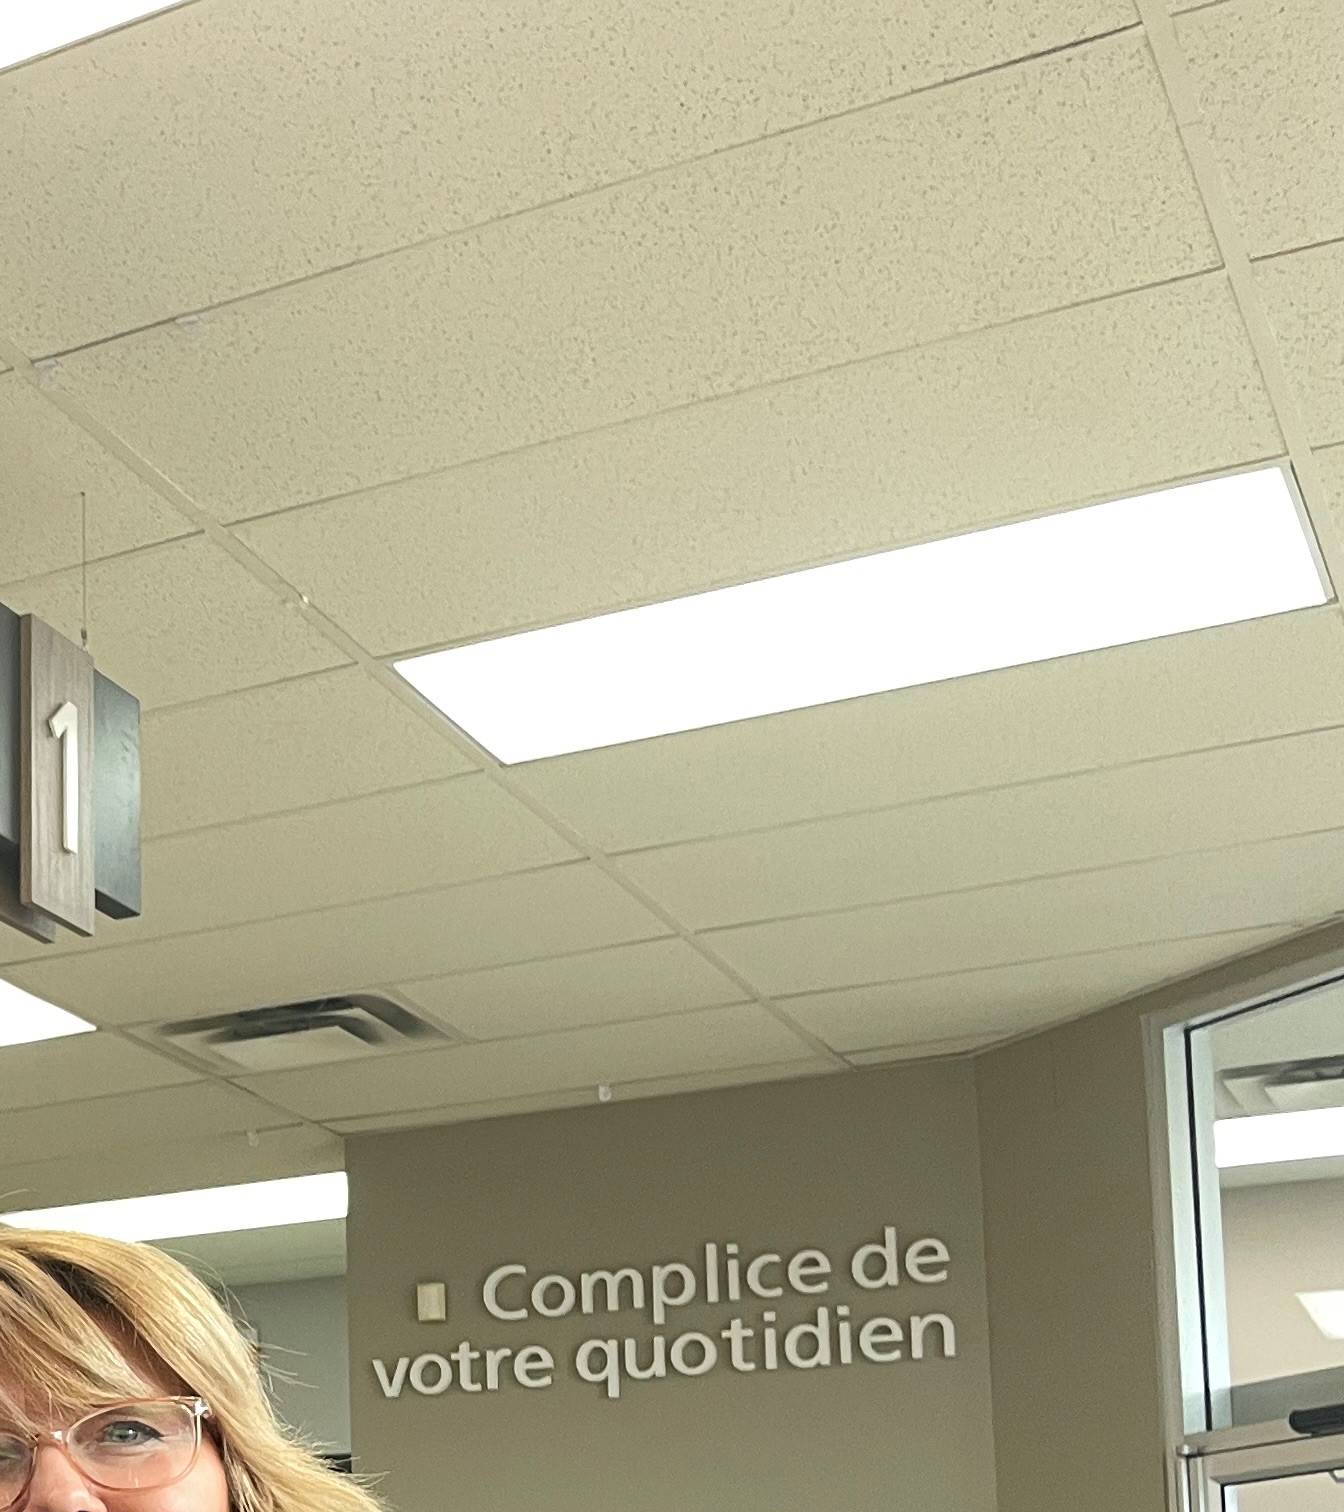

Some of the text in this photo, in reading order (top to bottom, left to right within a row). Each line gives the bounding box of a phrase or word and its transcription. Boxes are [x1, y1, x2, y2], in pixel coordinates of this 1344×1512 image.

[482, 1225, 953, 1325] Complice de
[371, 1305, 958, 1399] votre quotidien
